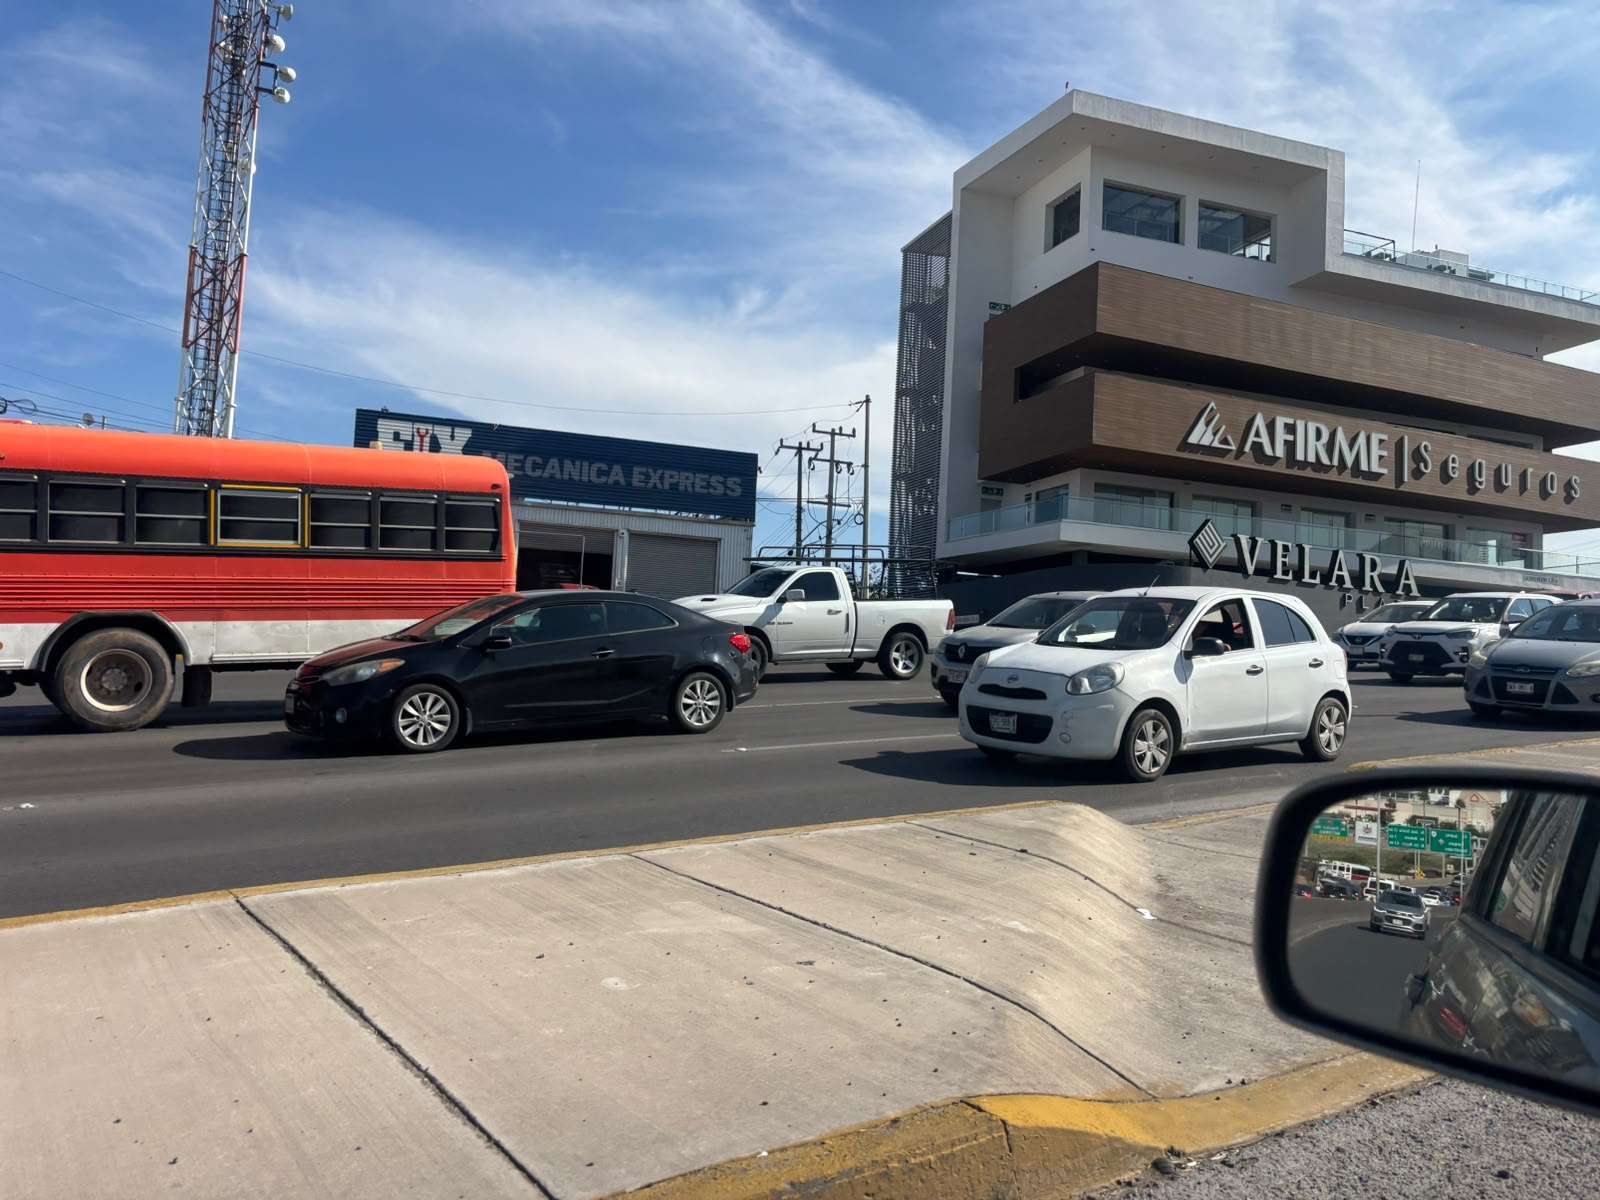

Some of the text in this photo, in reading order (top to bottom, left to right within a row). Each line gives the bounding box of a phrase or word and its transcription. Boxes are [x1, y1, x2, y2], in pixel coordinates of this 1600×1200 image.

[632, 466, 743, 497] EXPRESS
[1244, 412, 1580, 498] AFIRME Seguros
[1237, 534, 1422, 597] VELARA
